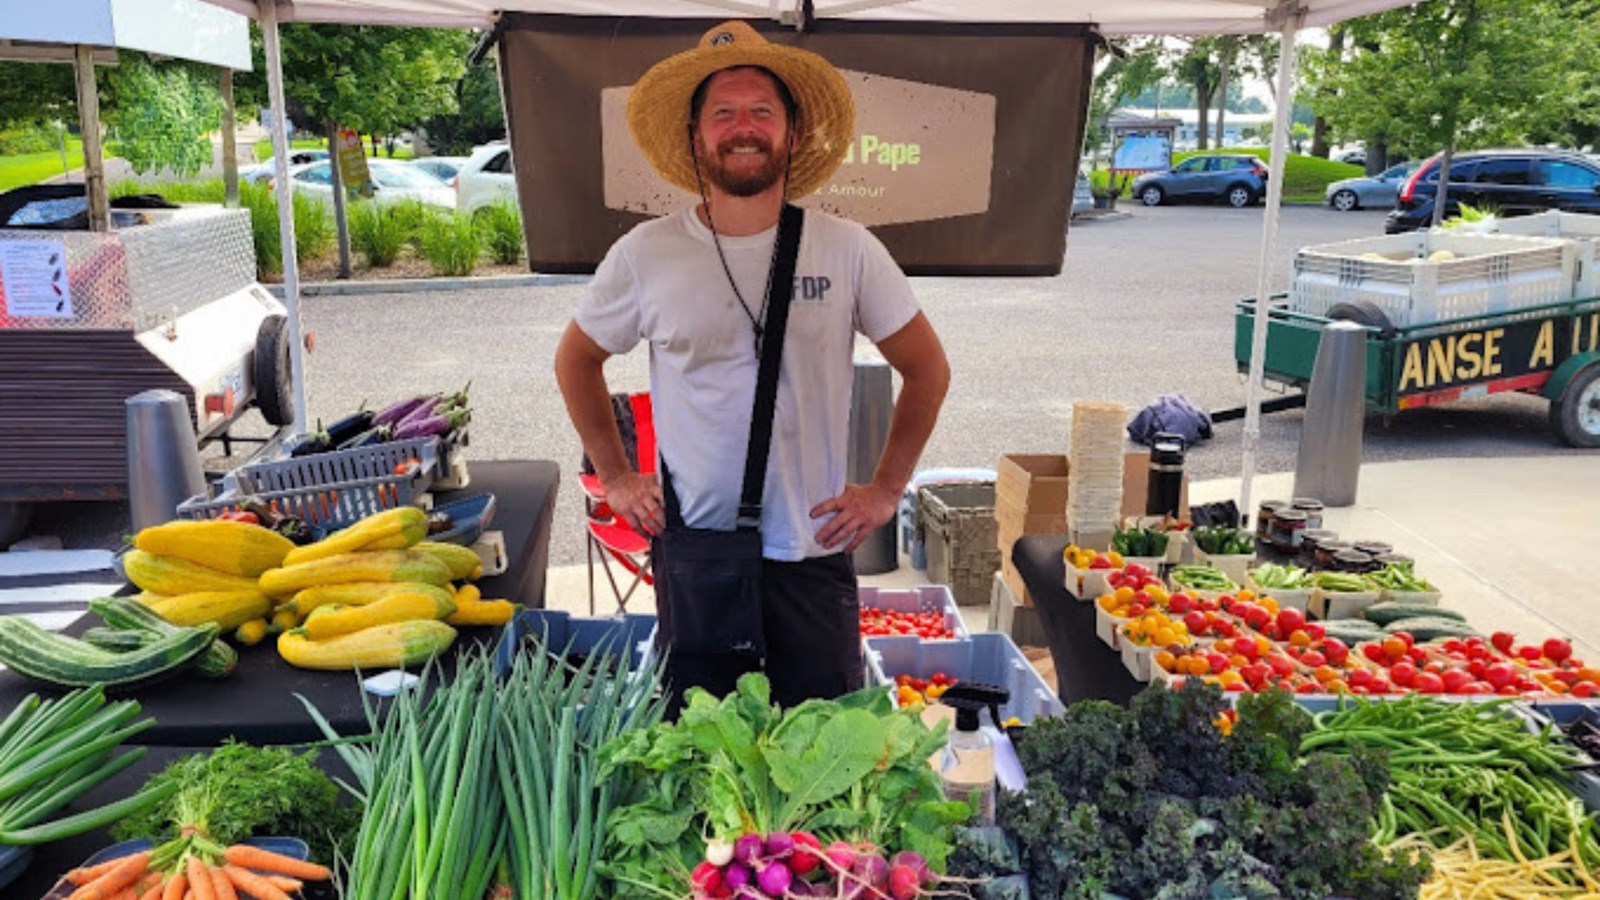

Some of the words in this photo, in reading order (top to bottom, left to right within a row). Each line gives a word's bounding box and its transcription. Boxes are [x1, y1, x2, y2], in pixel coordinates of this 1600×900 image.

[861, 134, 921, 172] Pape
[828, 184, 886, 197] Amour
[1398, 328, 1505, 391] ANSE
[1528, 319, 1555, 369] A
